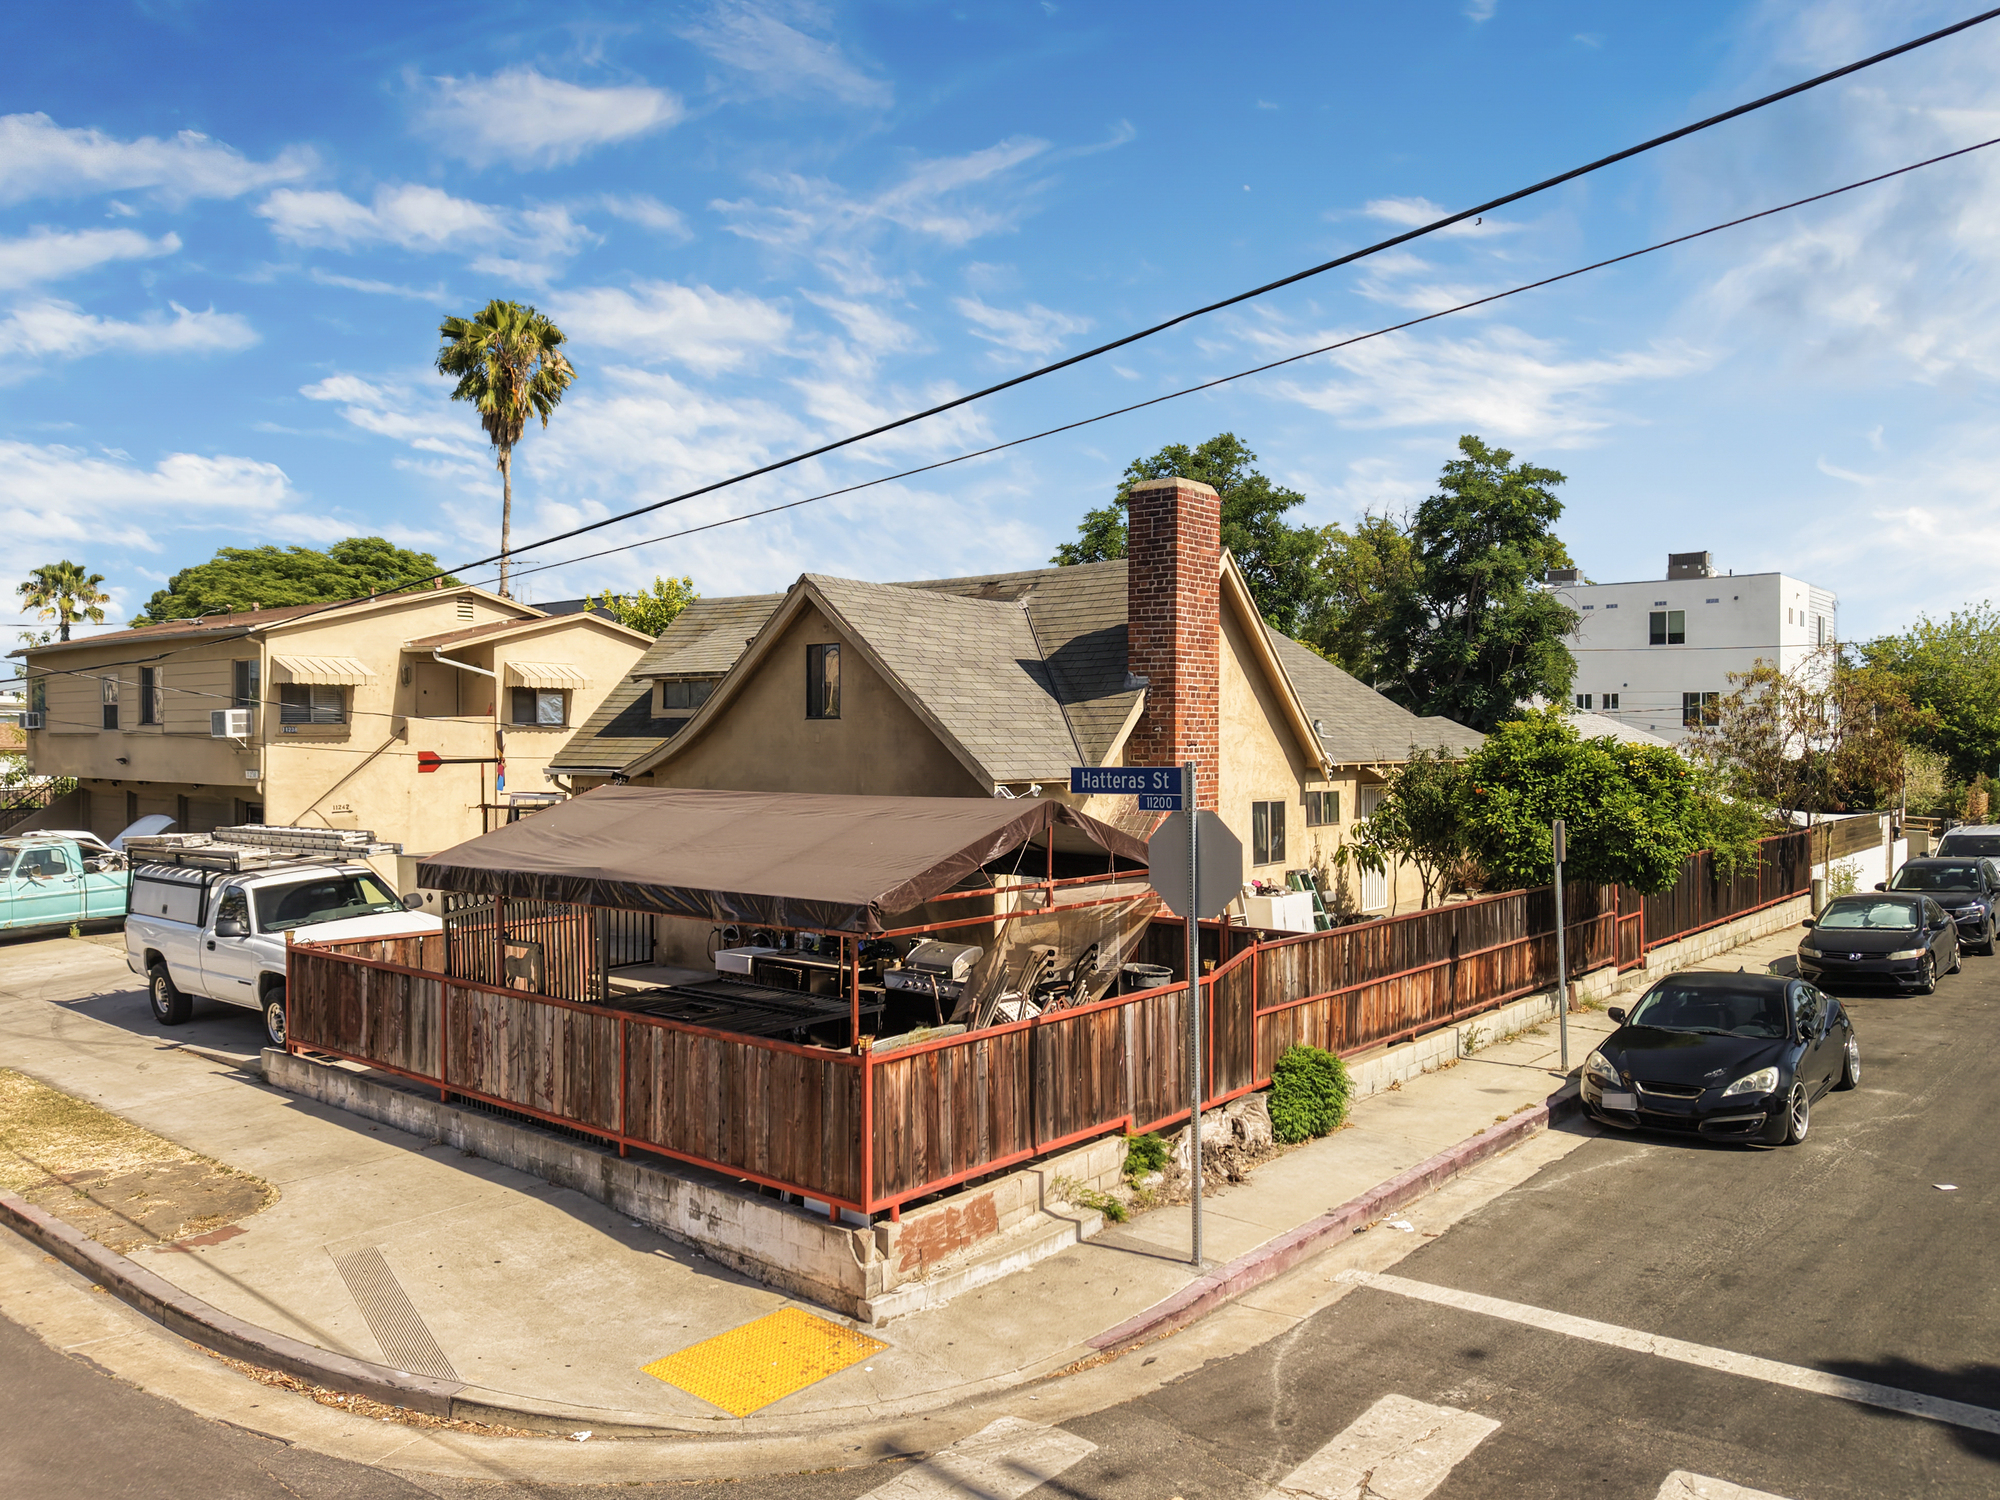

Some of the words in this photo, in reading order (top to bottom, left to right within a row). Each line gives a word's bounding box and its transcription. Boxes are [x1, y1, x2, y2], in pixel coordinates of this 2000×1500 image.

[1081, 771, 1146, 789] Hatteras
[1152, 771, 1170, 789] St
[1146, 796, 1173, 809] 11200
